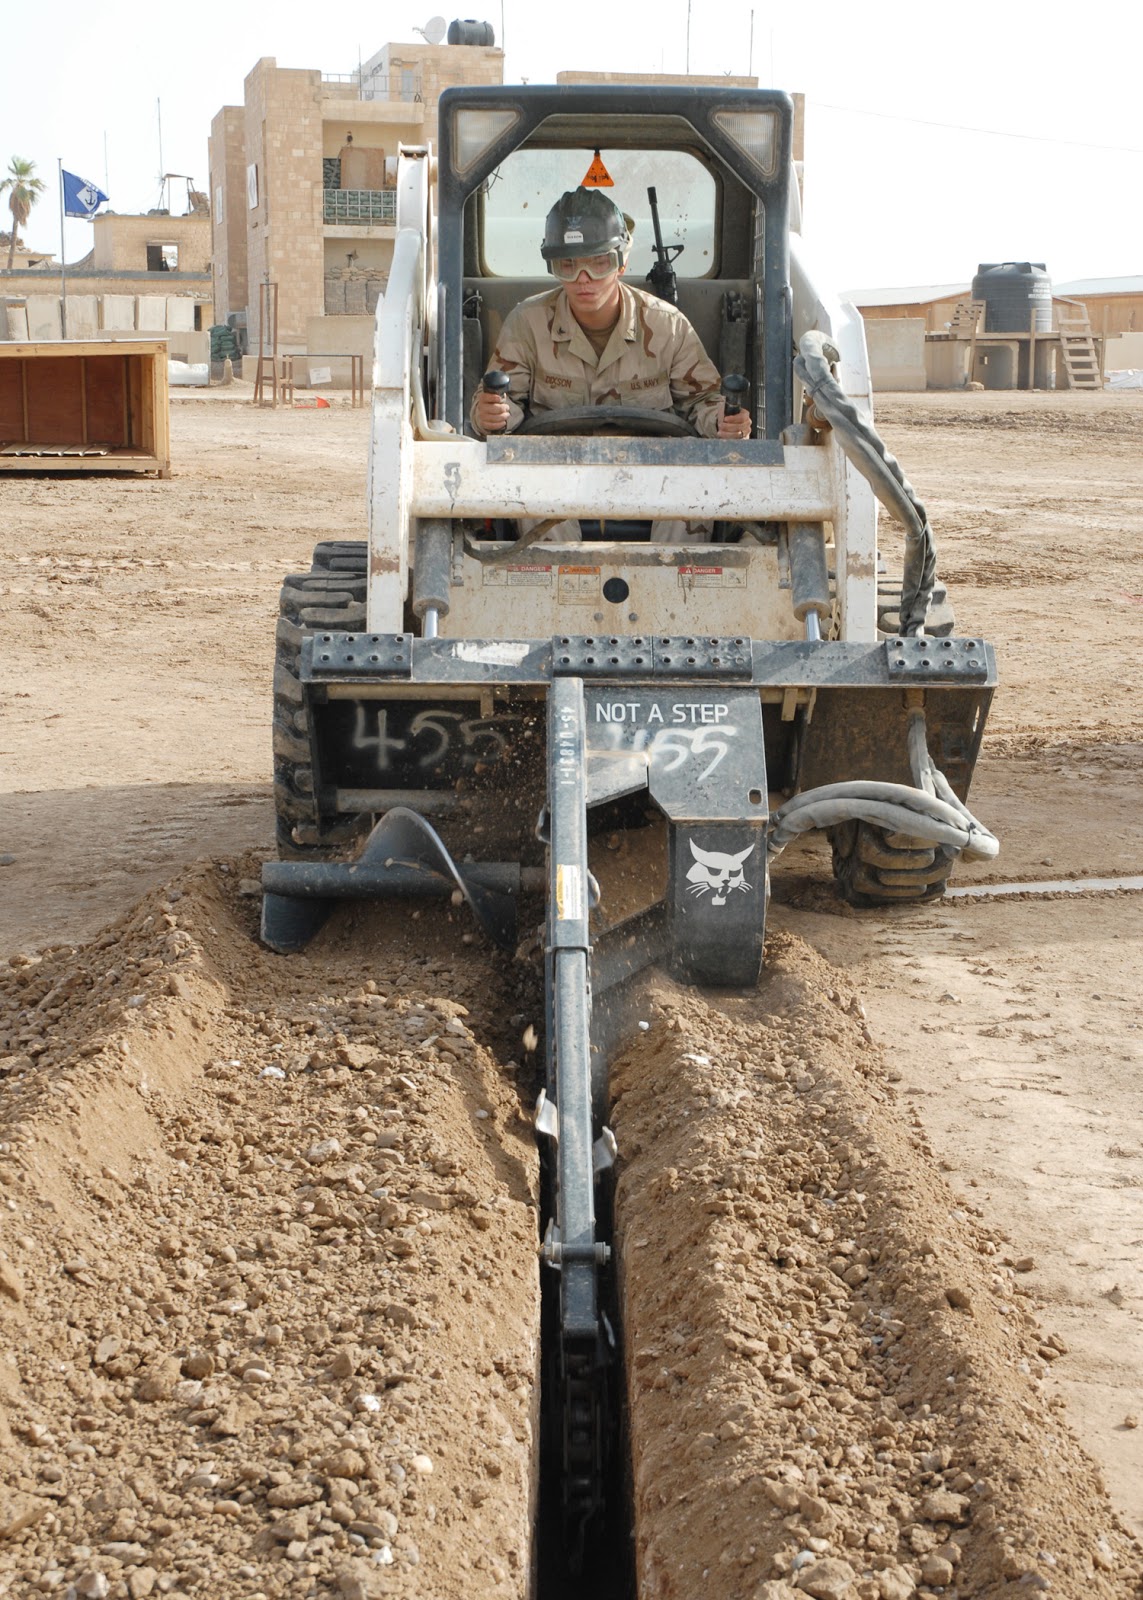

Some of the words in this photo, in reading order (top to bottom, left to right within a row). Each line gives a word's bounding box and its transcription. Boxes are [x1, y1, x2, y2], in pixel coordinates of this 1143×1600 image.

[545, 375, 572, 389] DIXSON
[643, 378, 659, 388] NAVY
[595, 702, 641, 723] NOT
[647, 703, 664, 723] A
[672, 703, 729, 724] STEP
